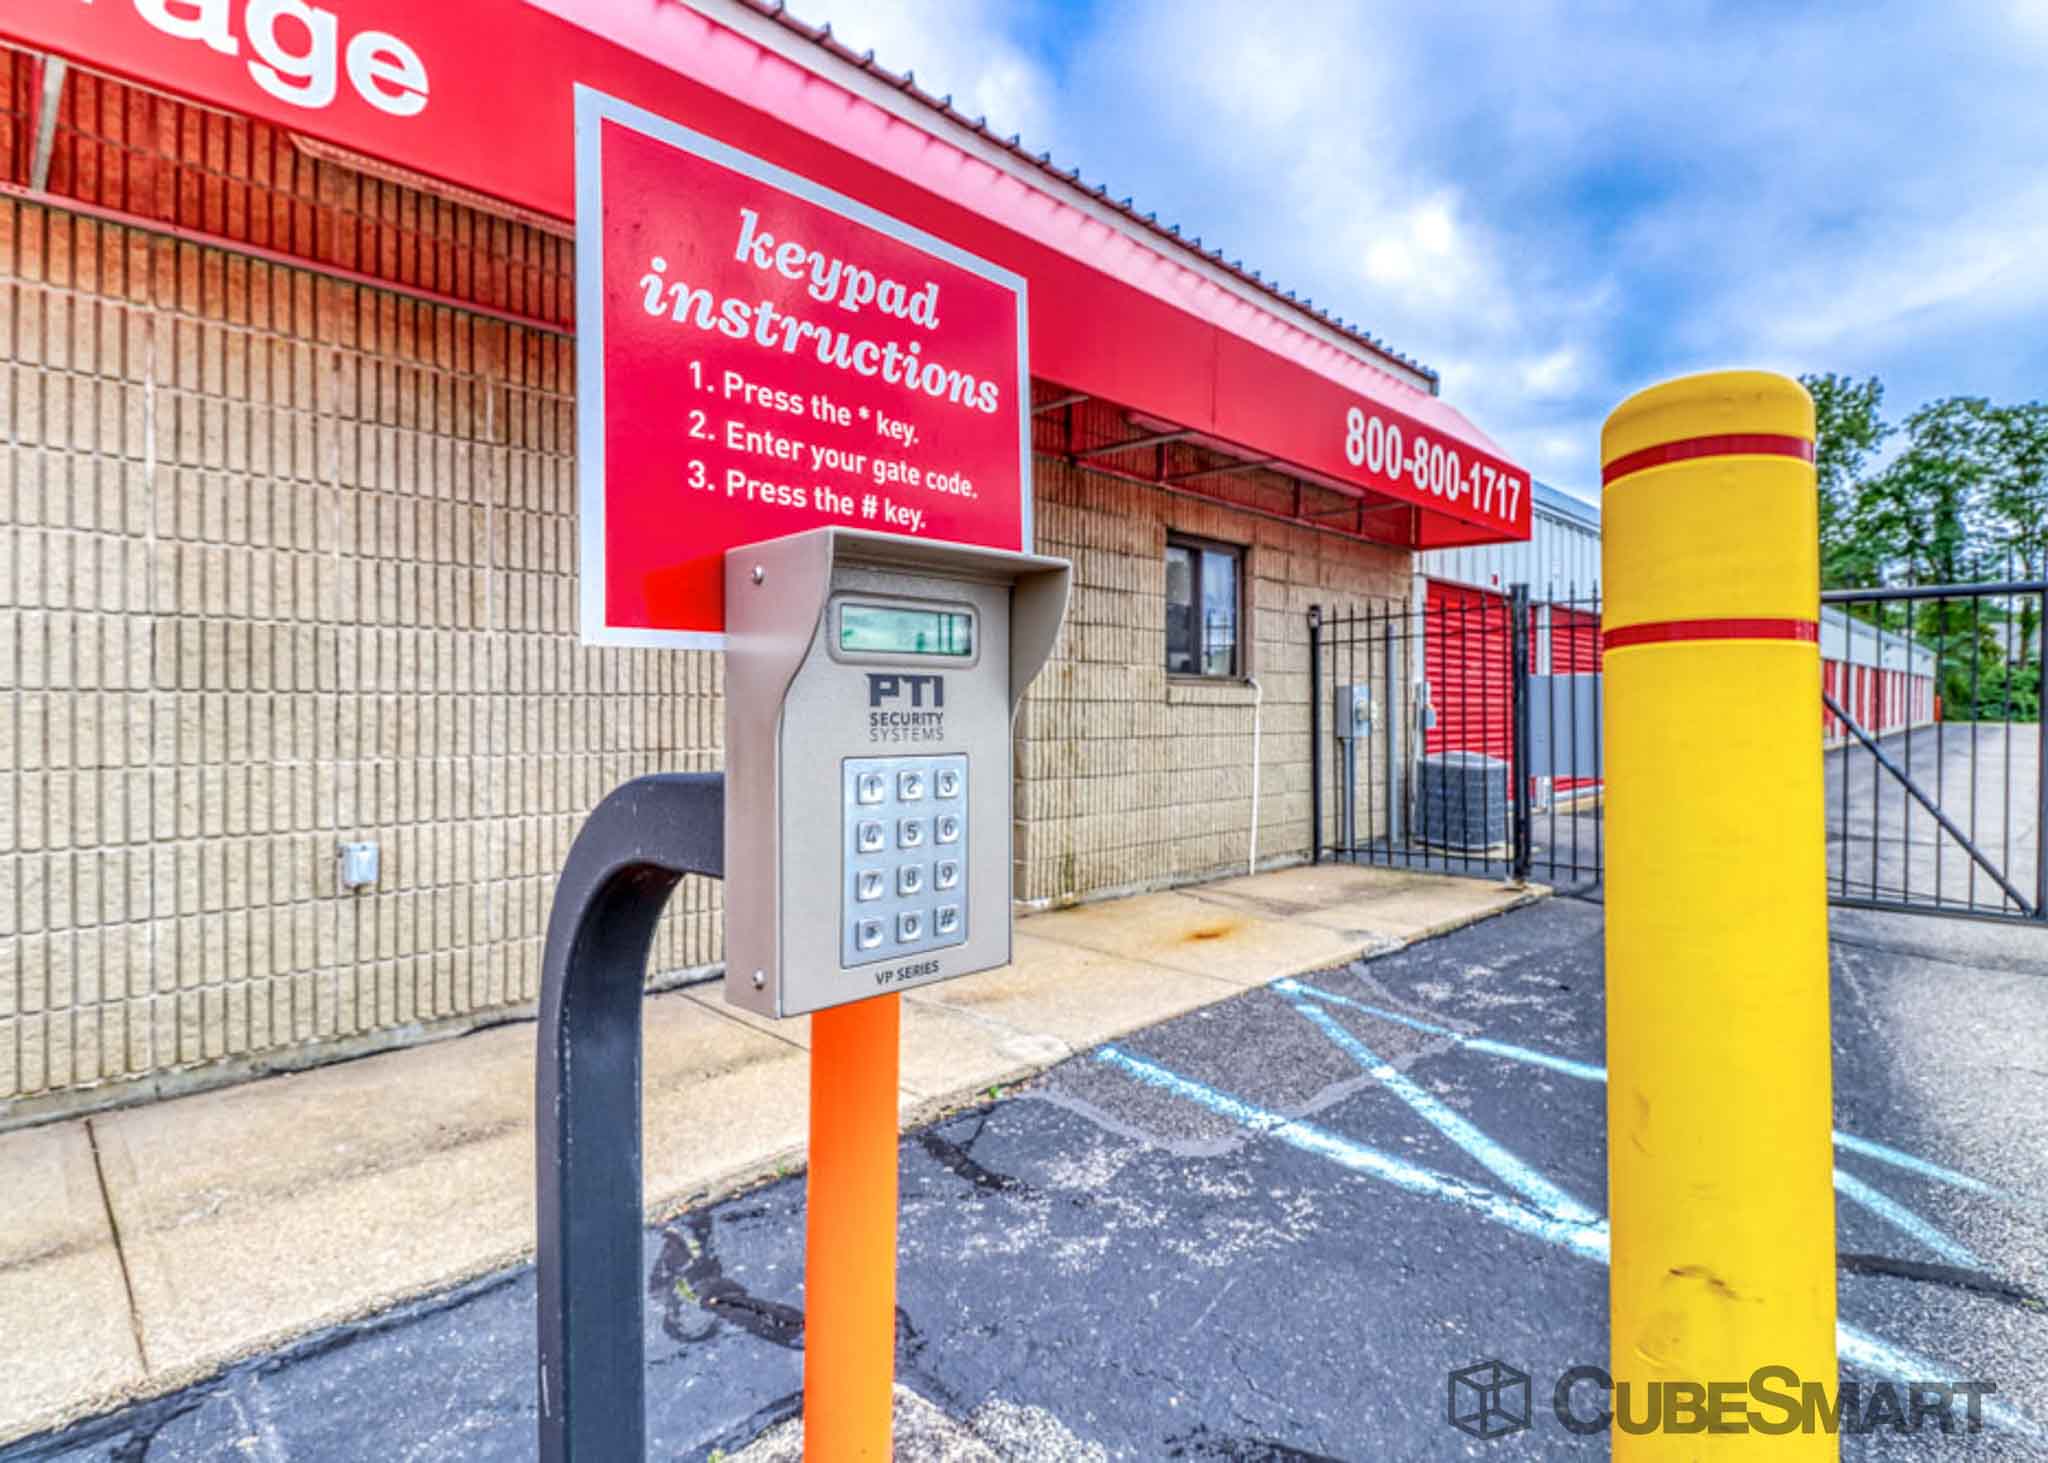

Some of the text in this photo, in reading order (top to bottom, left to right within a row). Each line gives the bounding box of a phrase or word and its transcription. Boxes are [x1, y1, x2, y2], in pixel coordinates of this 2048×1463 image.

[83, 0, 430, 116] age
[735, 208, 941, 330] keypad
[639, 256, 1000, 414] instructions
[689, 360, 715, 393] 1.
[724, 370, 806, 416] Press
[811, 394, 852, 427] the
[876, 410, 920, 448] key.
[687, 460, 927, 533] 3. Press the # key.
[688, 409, 979, 500] 2. Enter your gate code.
[1345, 407, 1521, 524] 800-800-1717
[865, 673, 944, 708] PTI
[869, 711, 944, 727] SECURITY
[869, 727, 944, 743] SYSTEMS
[875, 960, 940, 985] VP SERIES
